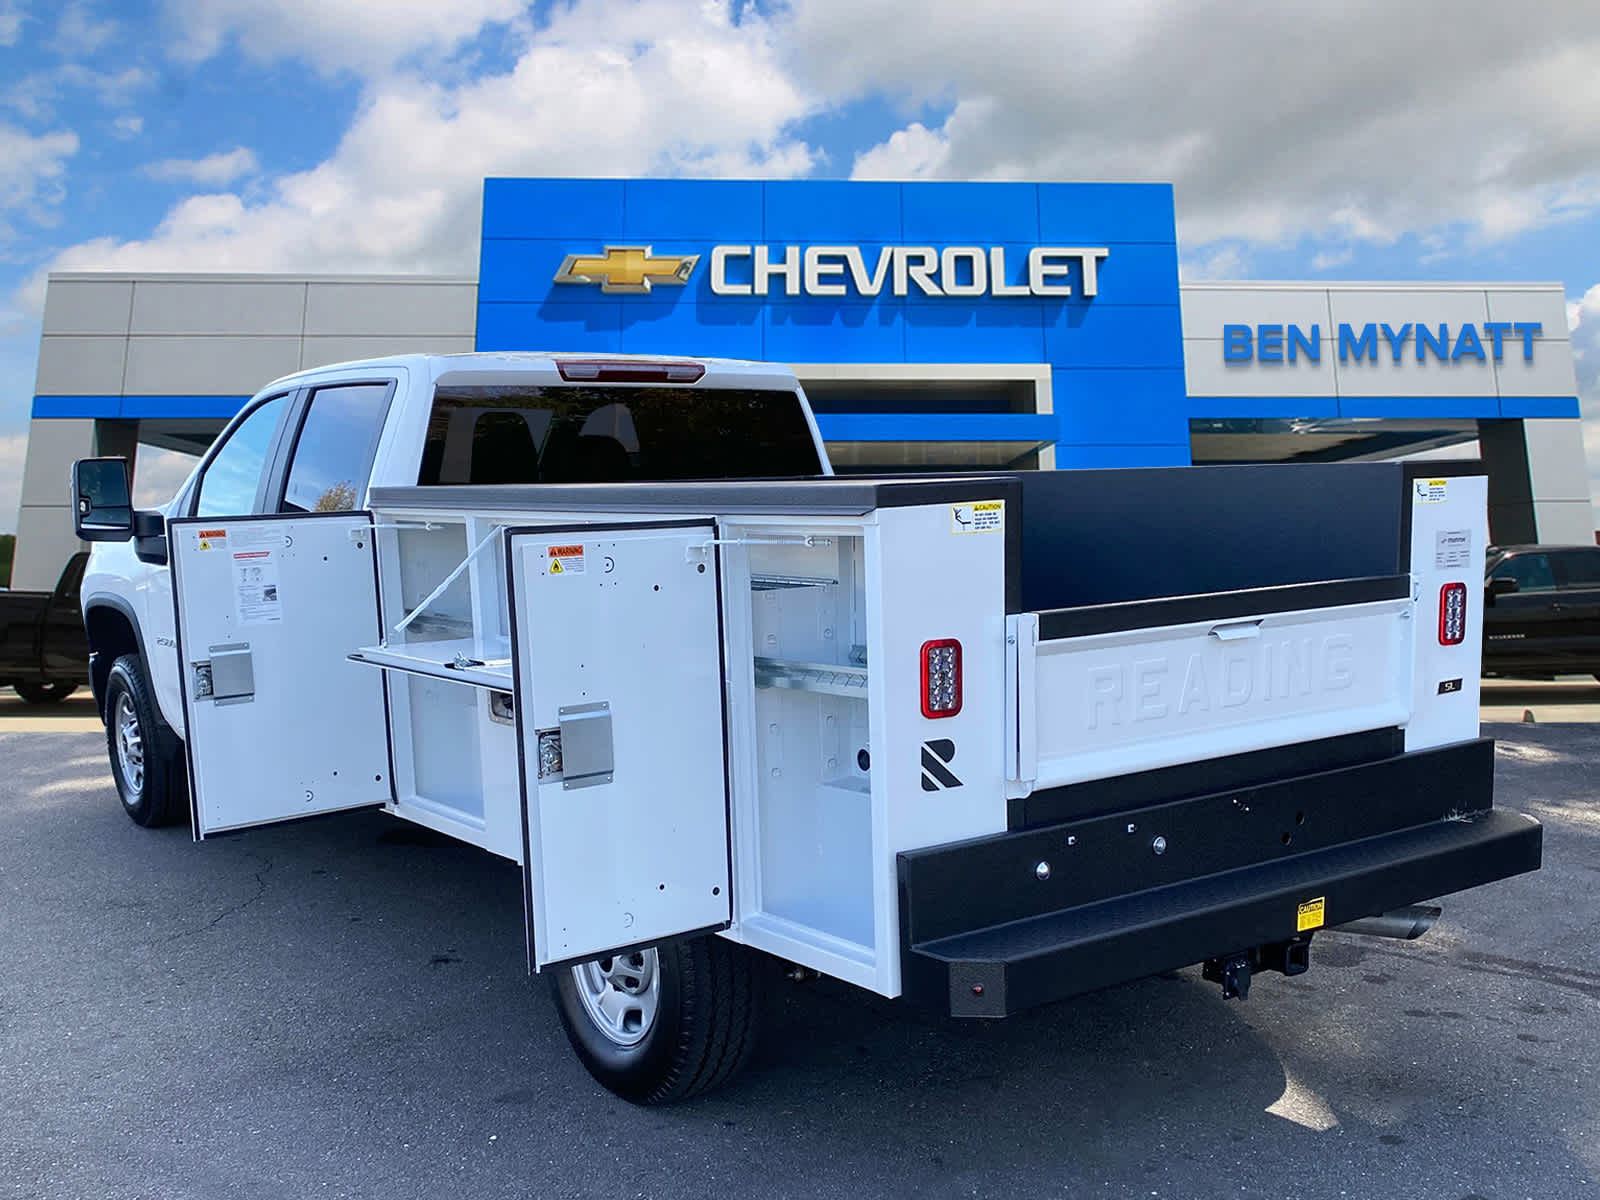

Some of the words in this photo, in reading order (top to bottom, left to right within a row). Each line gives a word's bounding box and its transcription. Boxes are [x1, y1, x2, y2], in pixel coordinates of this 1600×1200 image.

[710, 244, 1110, 297] CHEVROLET
[1223, 324, 1321, 363] BEN
[1338, 321, 1543, 363] MYNATT
[558, 546, 583, 557] WARNING
[1087, 632, 1354, 731] READING
[1299, 901, 1322, 914] CAUTION
